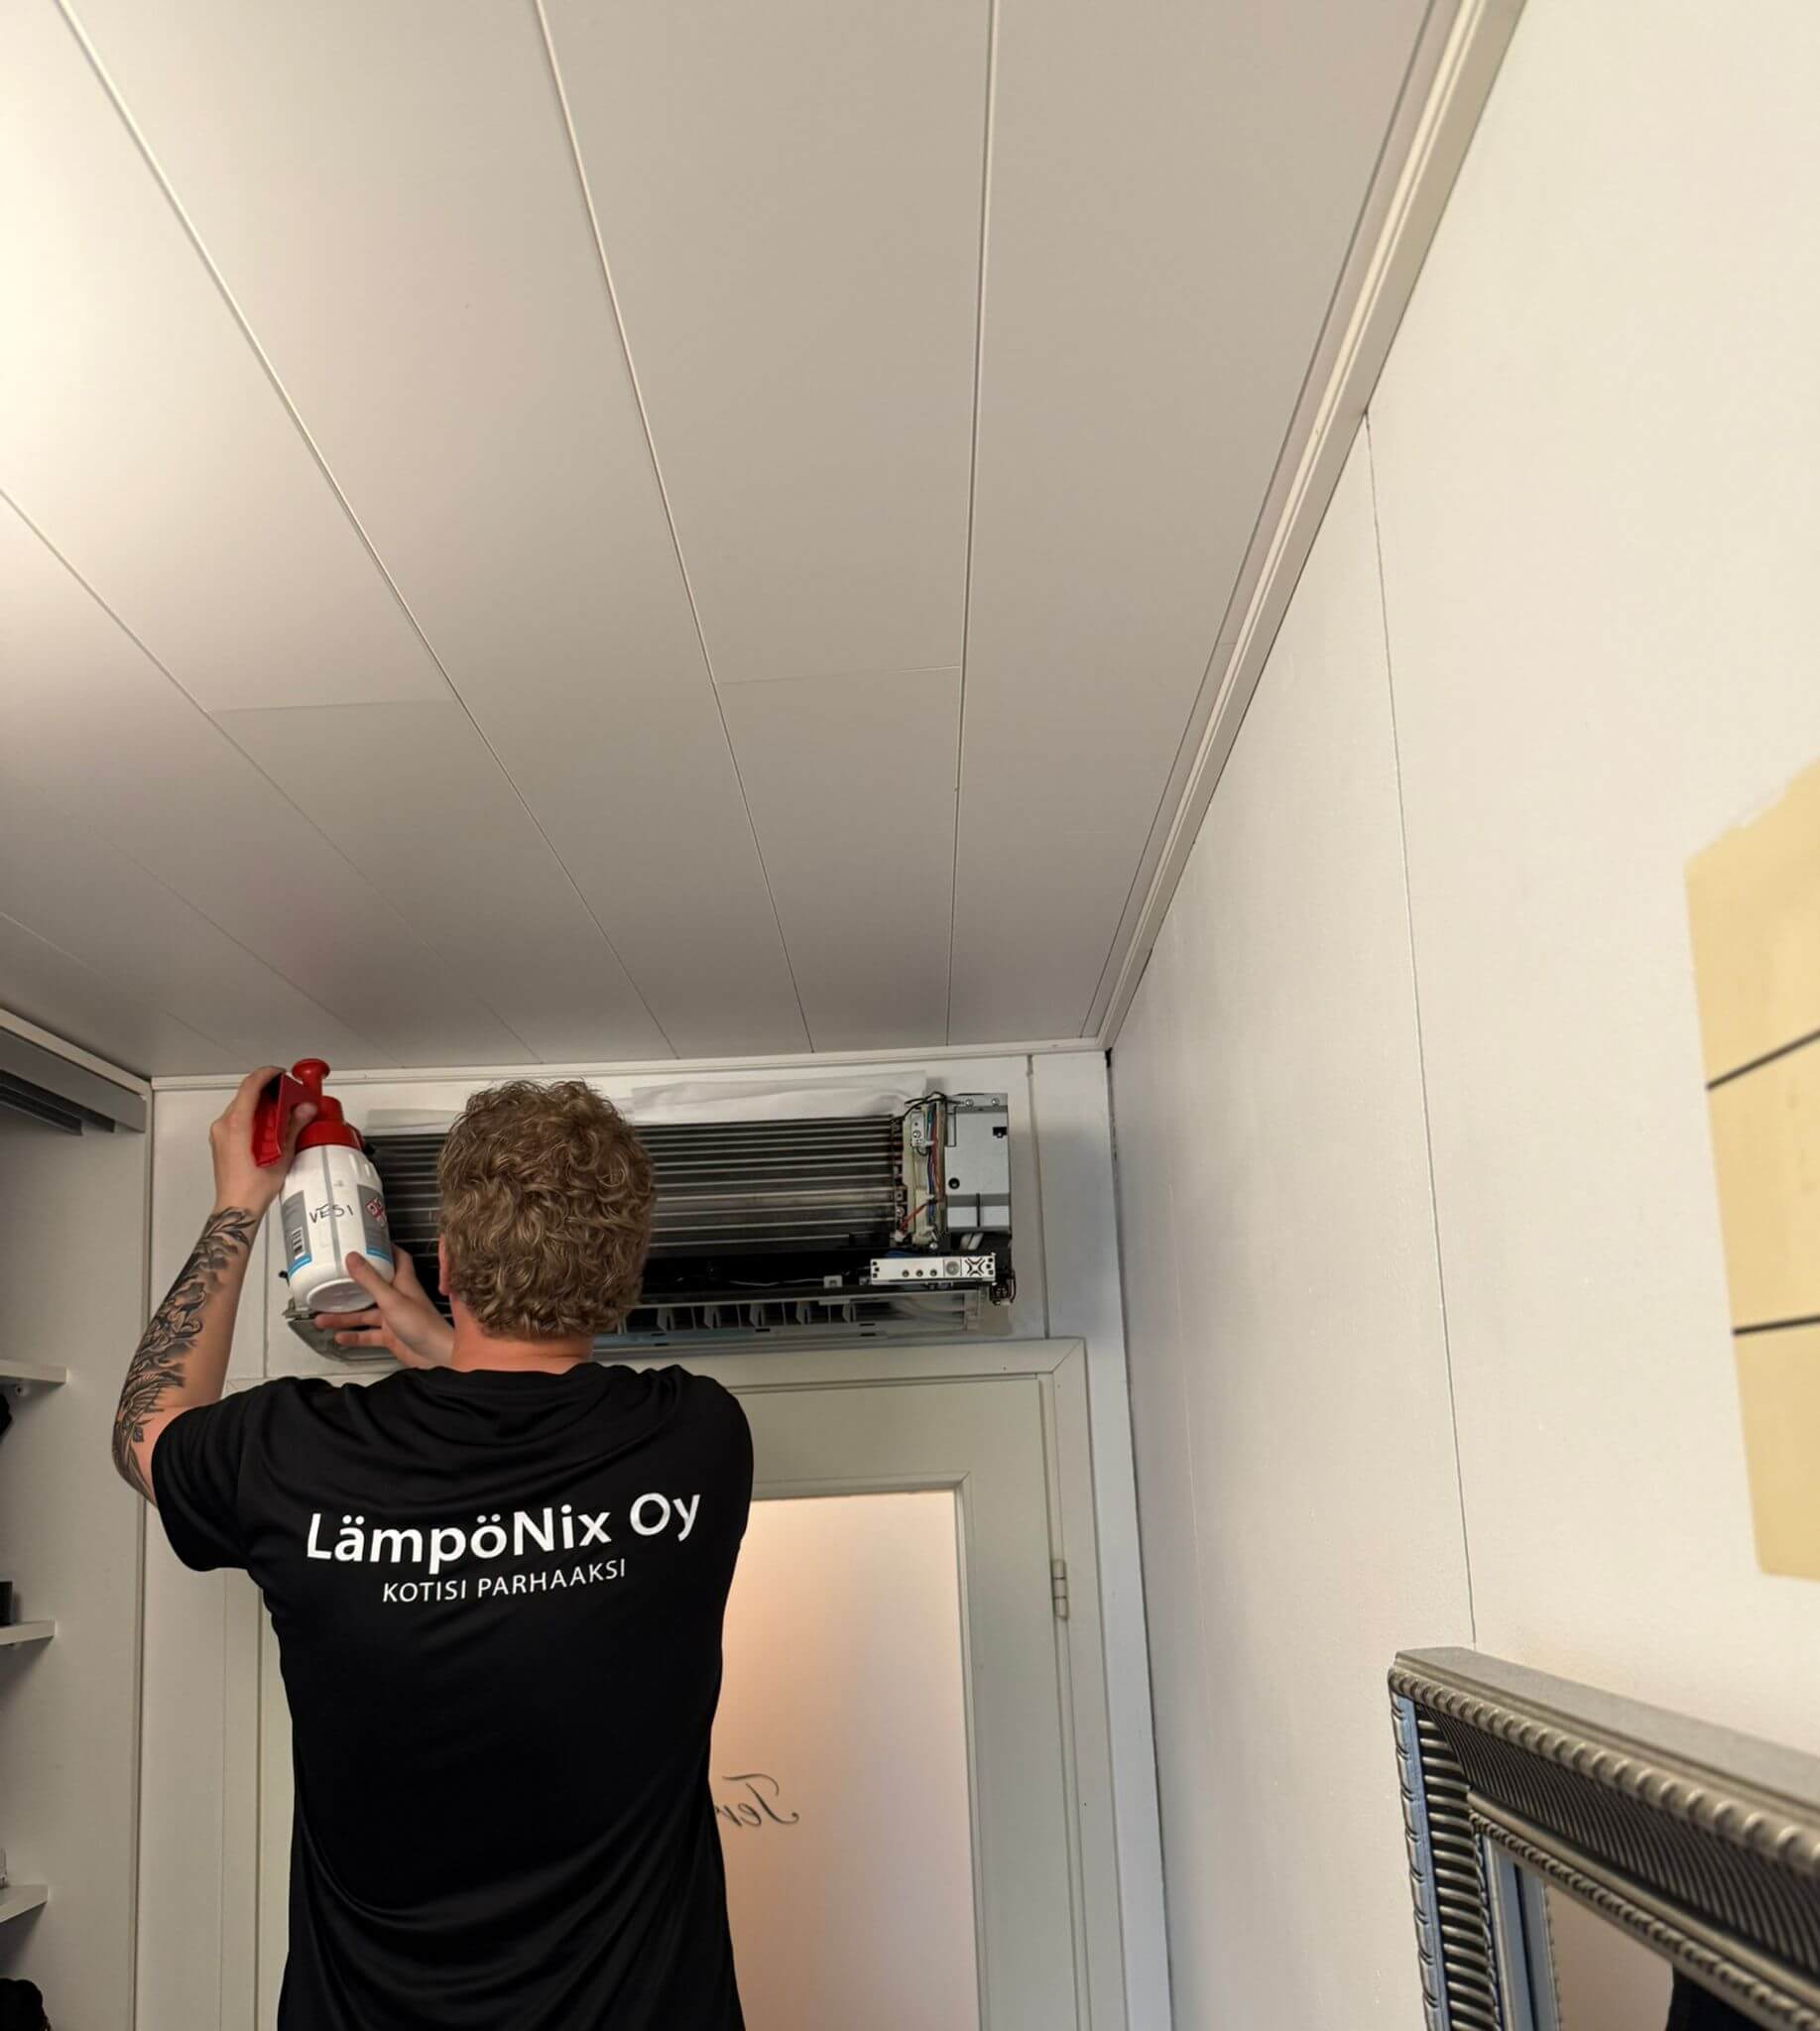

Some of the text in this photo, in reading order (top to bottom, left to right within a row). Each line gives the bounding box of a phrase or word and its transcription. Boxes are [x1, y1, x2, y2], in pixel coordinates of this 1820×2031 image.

[308, 1202, 354, 1224] VESI
[305, 1492, 701, 1575] LämpöNix Oy
[382, 1558, 626, 1604] KOTISI PARHAAKSI
